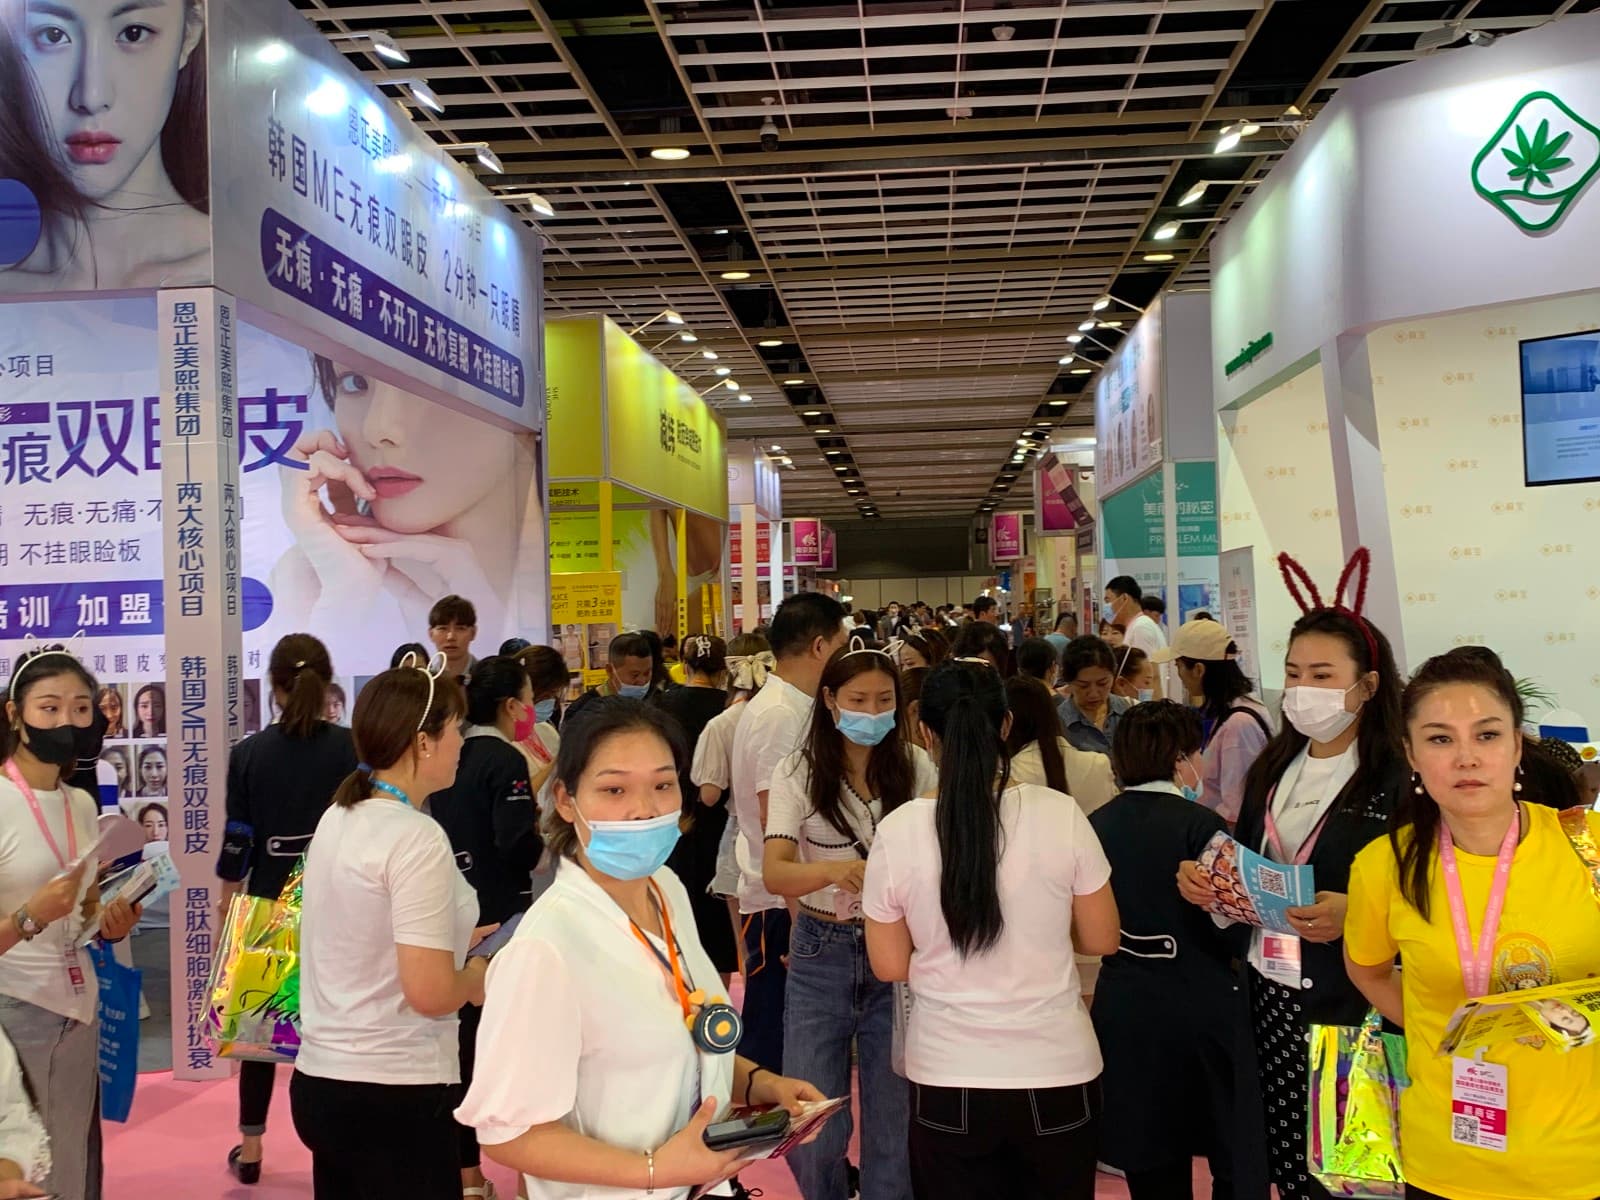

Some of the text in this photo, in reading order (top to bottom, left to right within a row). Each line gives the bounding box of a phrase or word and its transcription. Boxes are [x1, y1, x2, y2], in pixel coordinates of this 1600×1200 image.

[268, 115, 428, 279] 韩国ME无痕双眼皮
